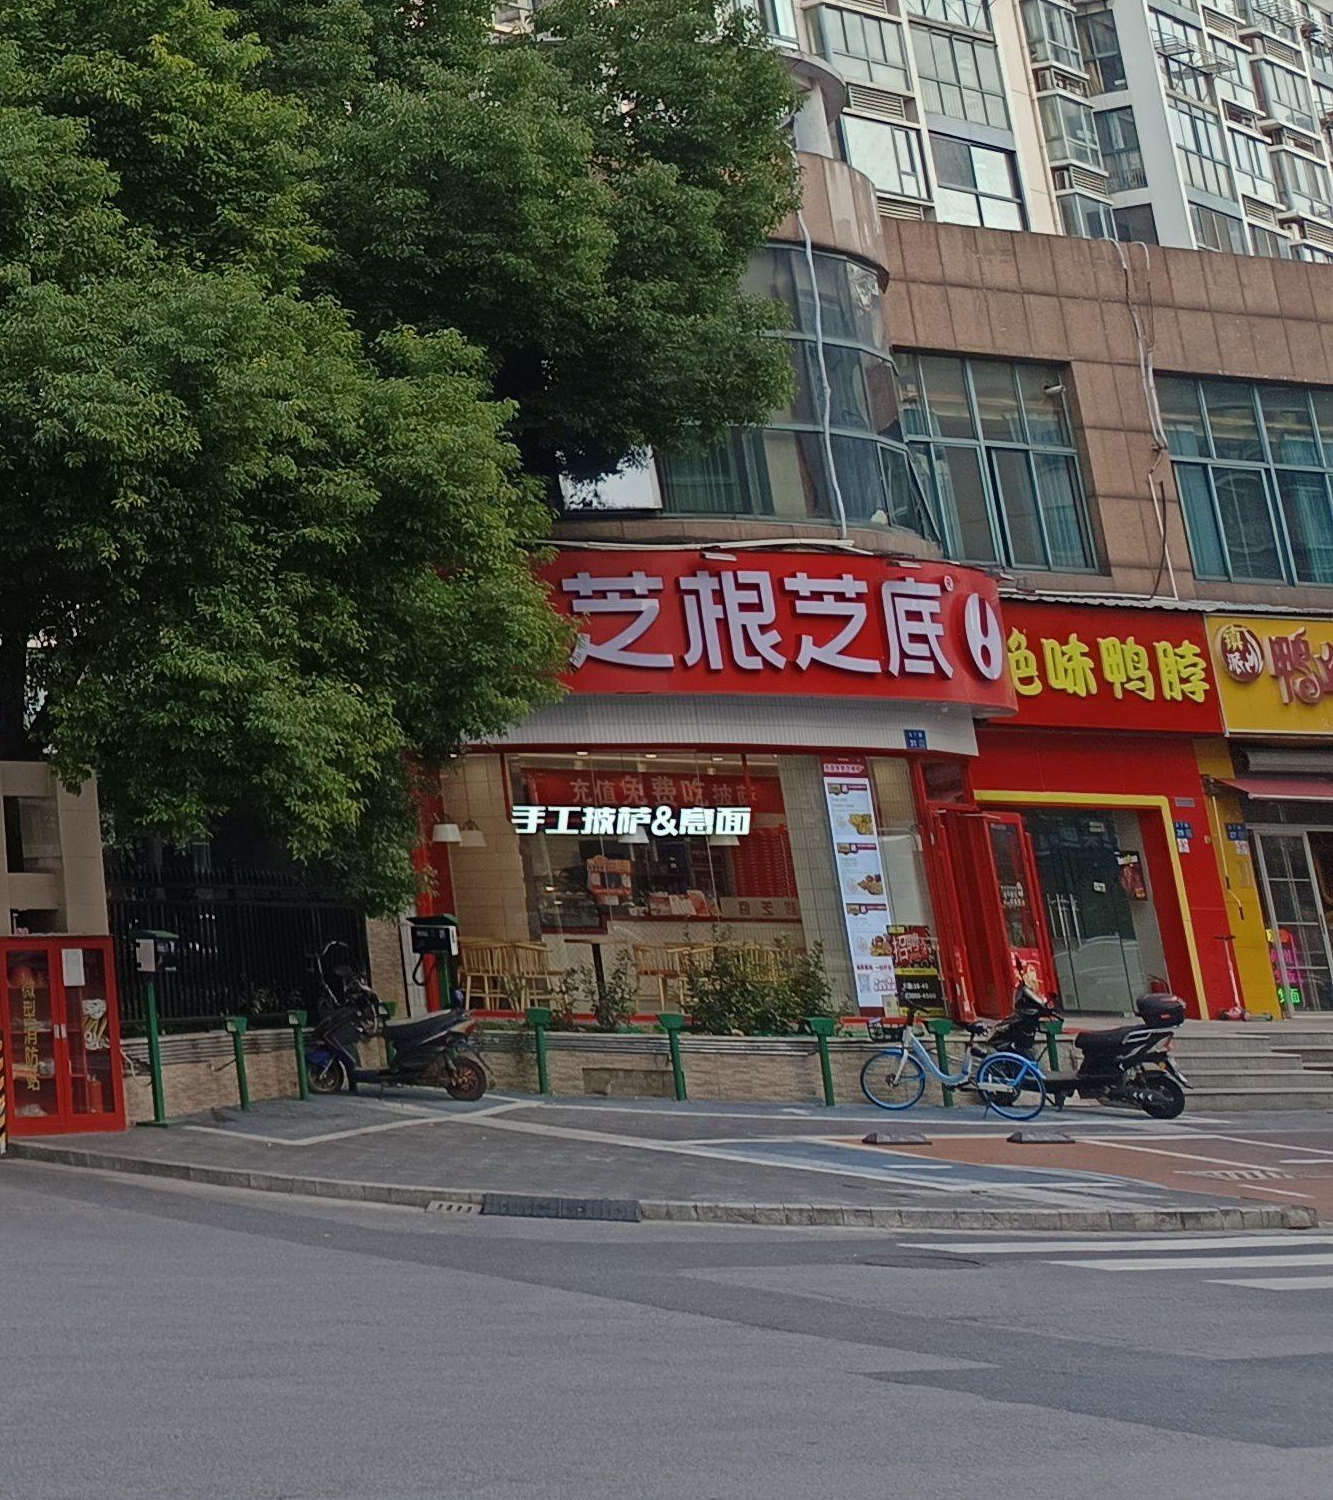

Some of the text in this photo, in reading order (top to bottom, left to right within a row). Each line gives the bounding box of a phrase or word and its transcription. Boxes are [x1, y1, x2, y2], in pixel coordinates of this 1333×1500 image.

[561, 570, 955, 679] 芝根芝底
[22, 971, 41, 1091] 微型消防站
